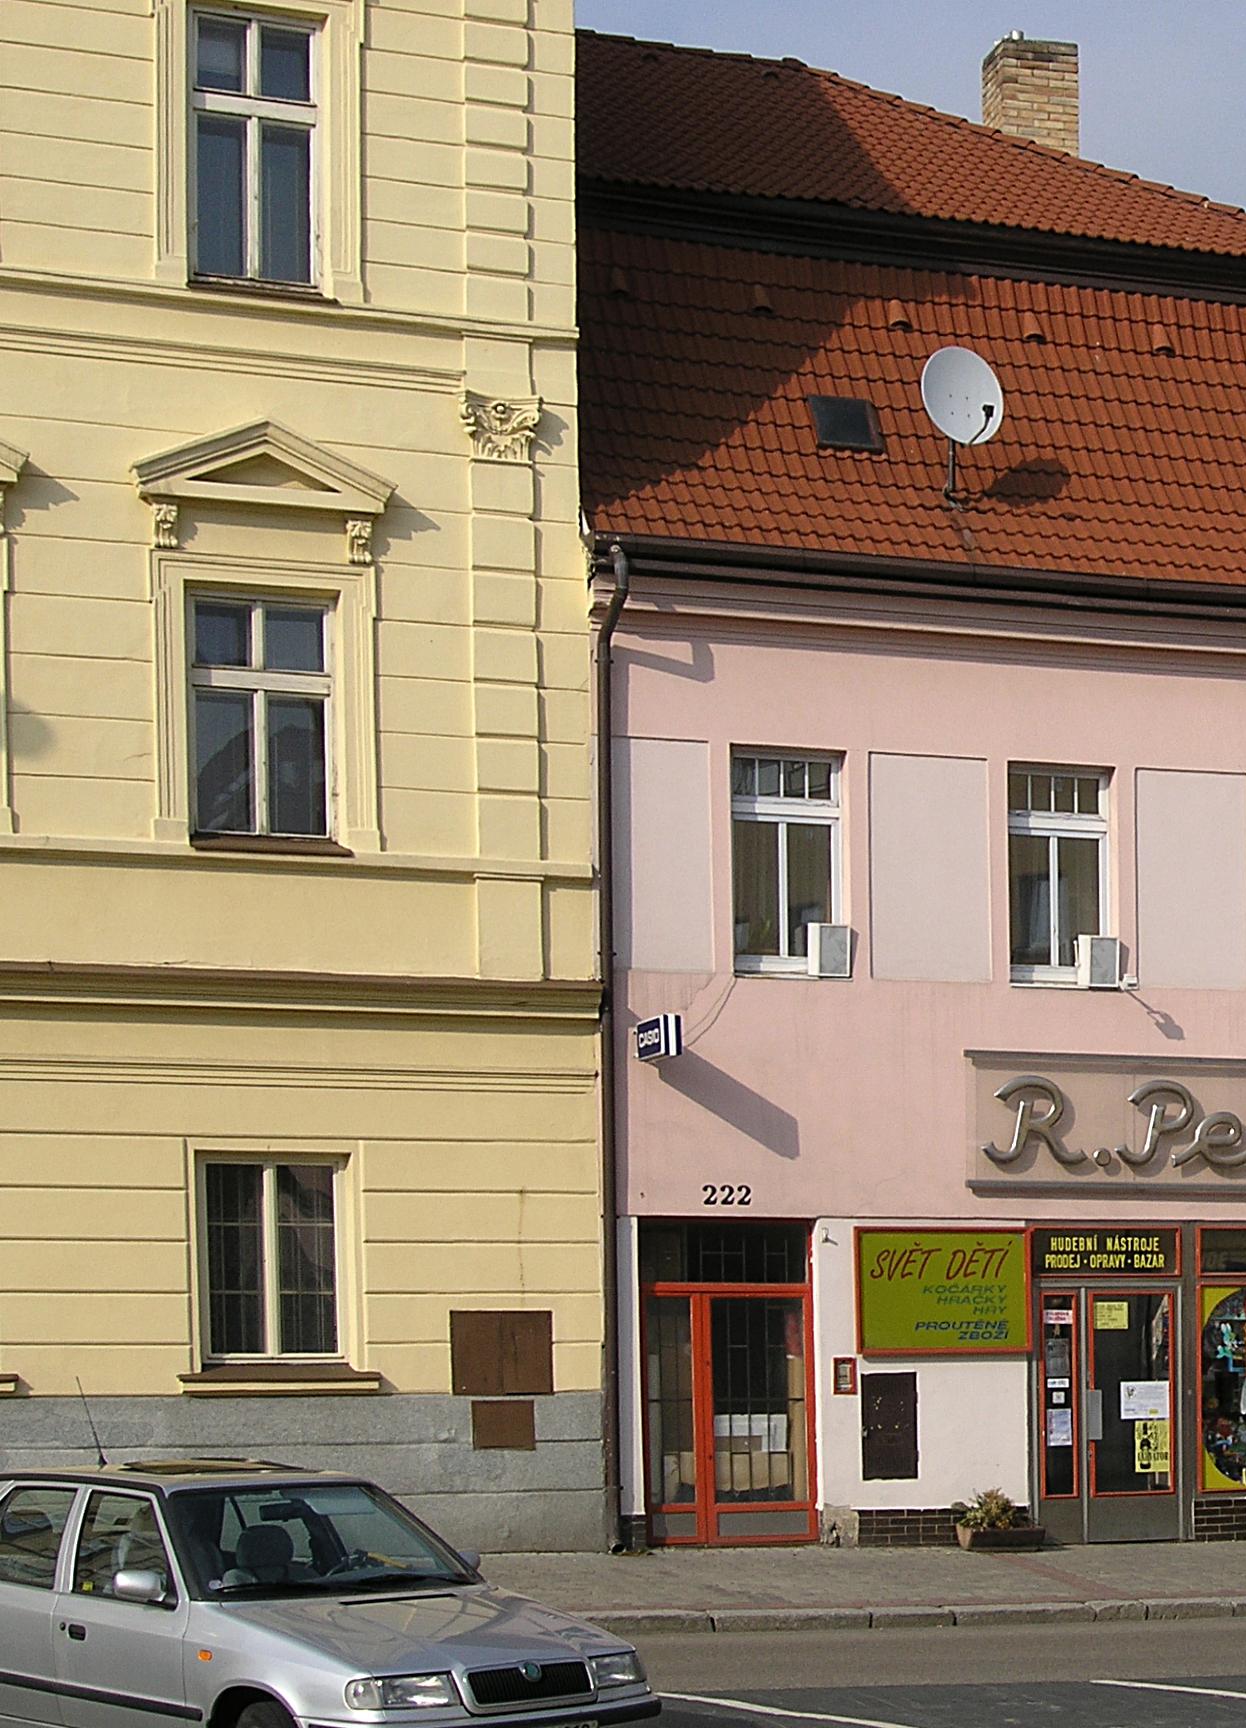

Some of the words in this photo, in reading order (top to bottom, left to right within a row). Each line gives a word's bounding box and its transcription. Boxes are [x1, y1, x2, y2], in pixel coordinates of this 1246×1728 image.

[638, 1028, 660, 1048] CASIO
[702, 1184, 752, 1206] 222
[1050, 1234, 1098, 1251] HUDEBNÍ
[1106, 1234, 1160, 1251] NÁSTROJE
[869, 1241, 942, 1282] SVĚT
[945, 1240, 1013, 1281] DĚTÍ
[1045, 1254, 1081, 1269] PRODEJ
[1089, 1254, 1126, 1269] OPRAVY
[1133, 1254, 1165, 1269] BAZAR
[973, 1306, 1007, 1316] HRY
